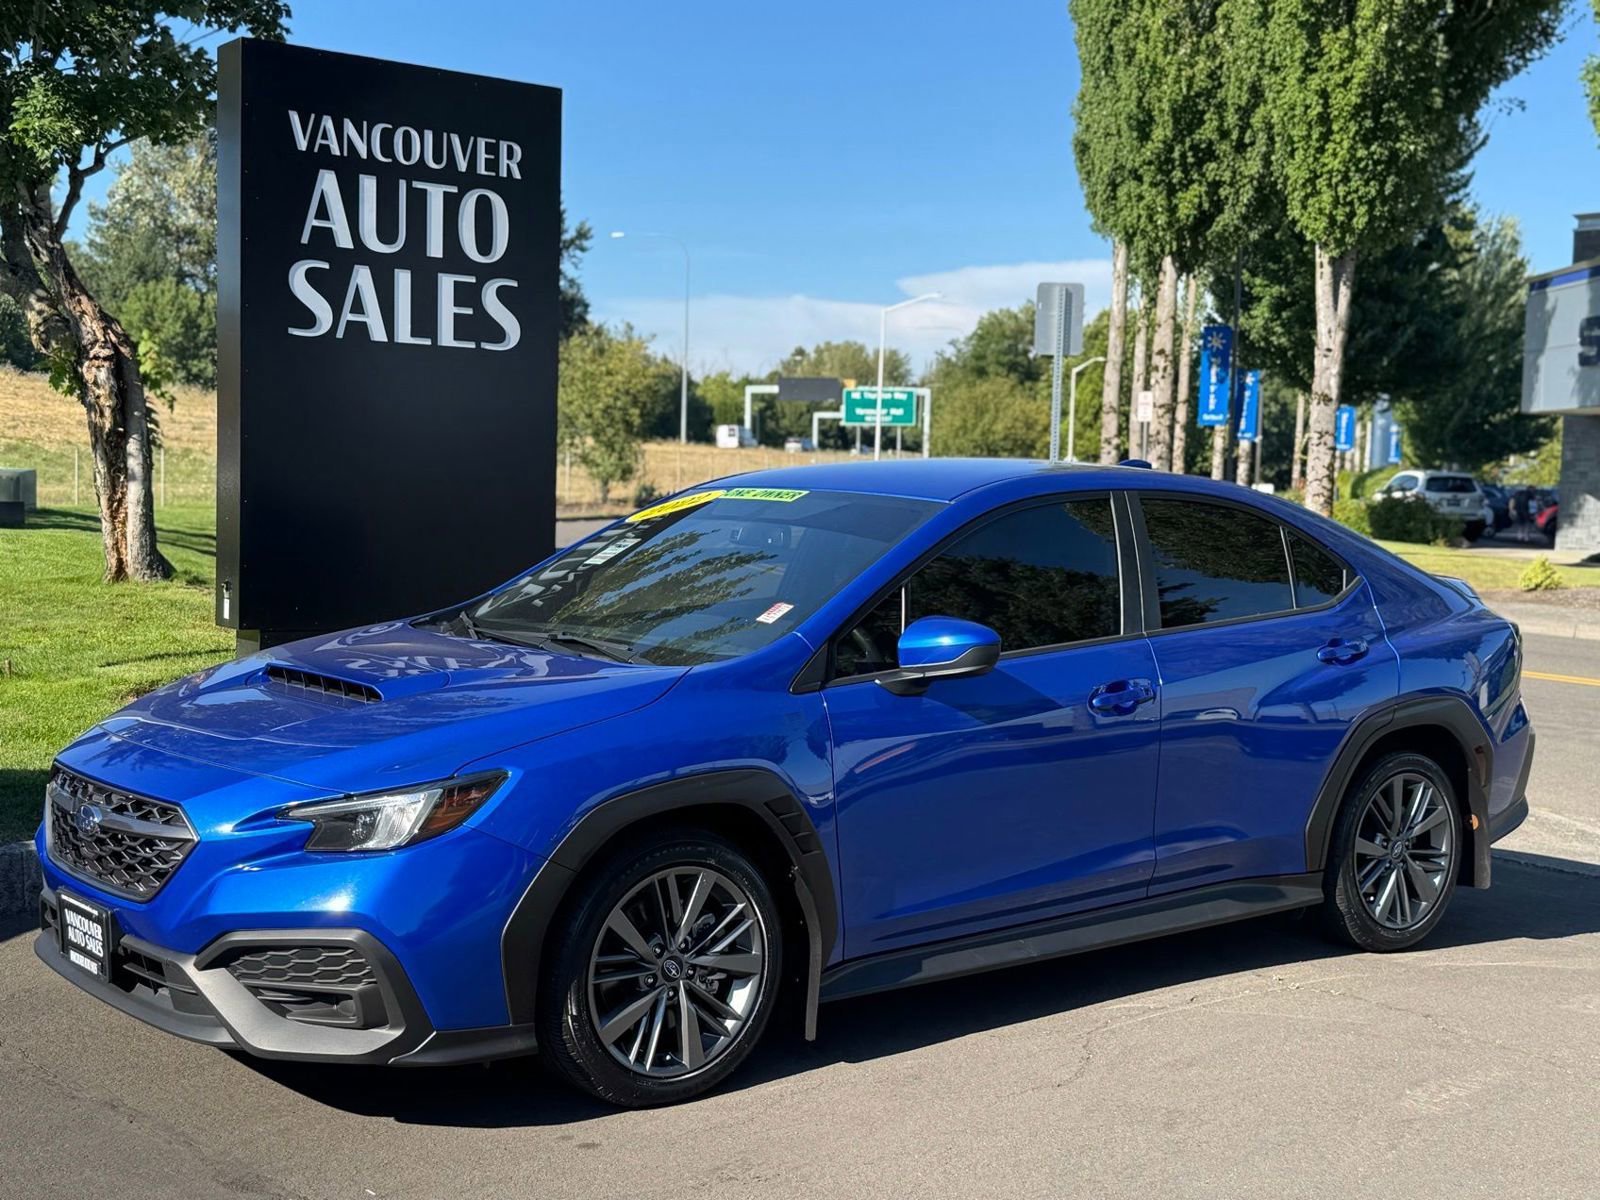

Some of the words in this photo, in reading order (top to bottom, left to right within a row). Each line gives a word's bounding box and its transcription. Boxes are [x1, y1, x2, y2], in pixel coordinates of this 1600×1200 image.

[288, 110, 522, 180] VANCOUVER
[300, 169, 510, 263] AUTO
[287, 259, 521, 351] SALES
[65, 908, 103, 941] VANCOUVER
[68, 926, 85, 947] AUTO
[86, 934, 104, 957] SALES
